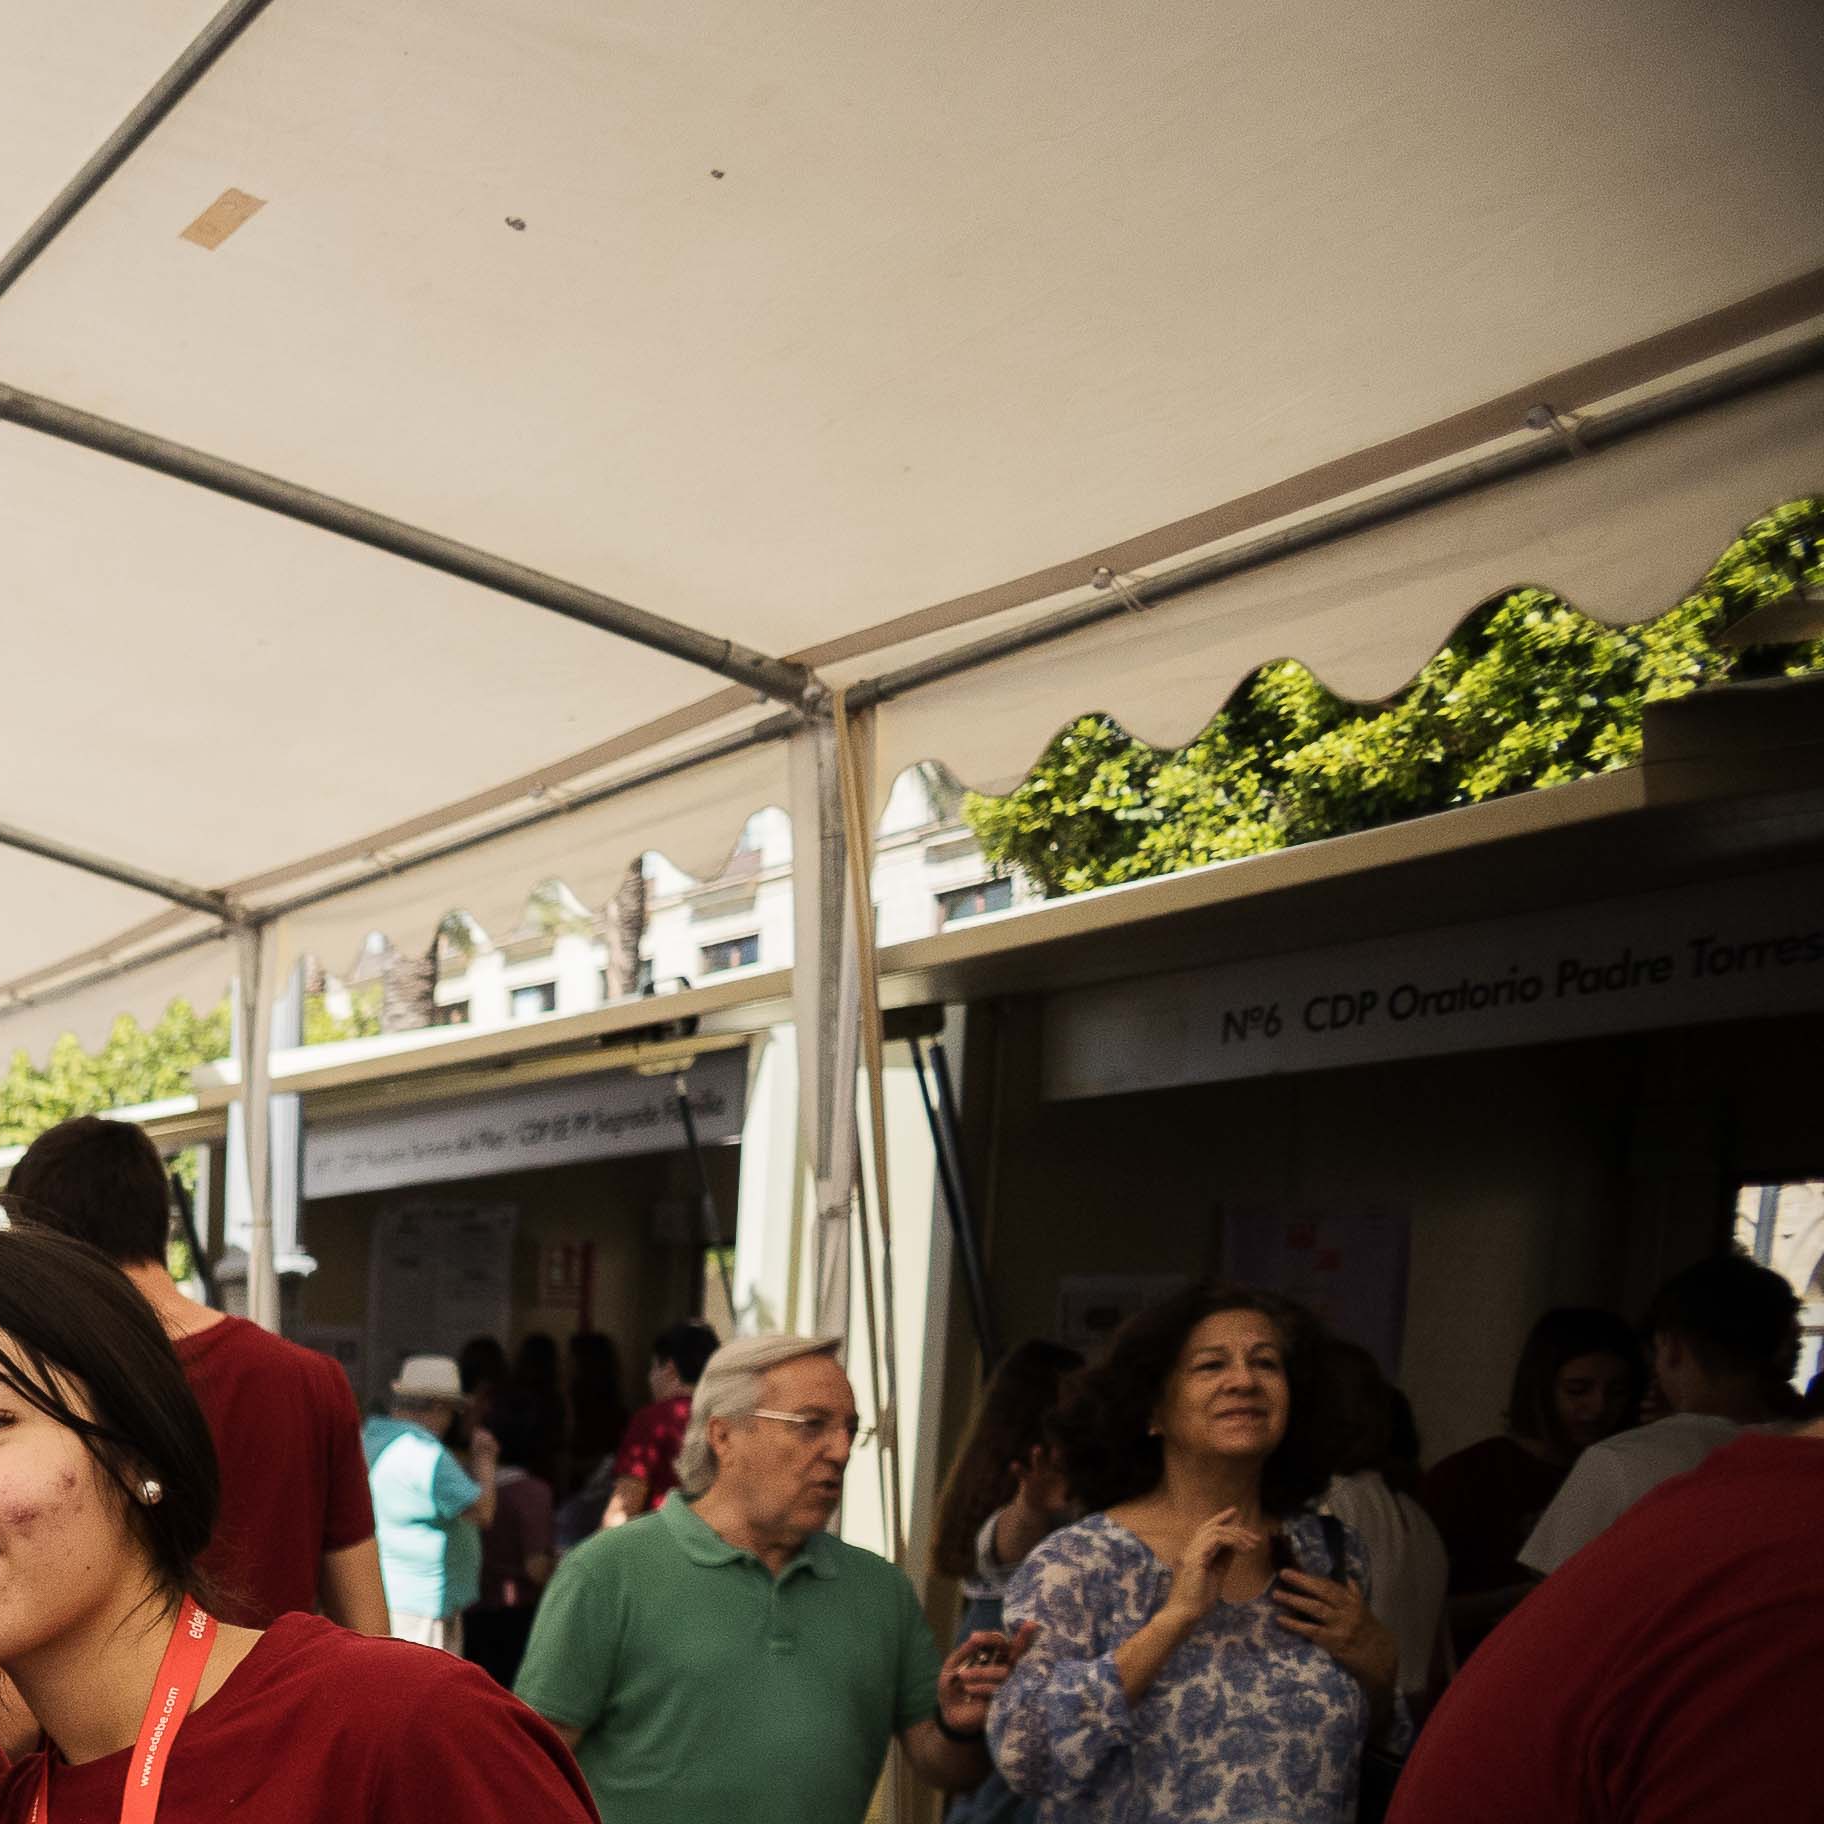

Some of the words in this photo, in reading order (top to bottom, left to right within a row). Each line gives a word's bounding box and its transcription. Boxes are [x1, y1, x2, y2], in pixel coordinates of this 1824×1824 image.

[1301, 990, 1378, 1034] CDP
[1388, 965, 1545, 1022] Oratorio
[1555, 948, 1674, 999] Padre
[139, 1687, 179, 1787] www.edebe.com
